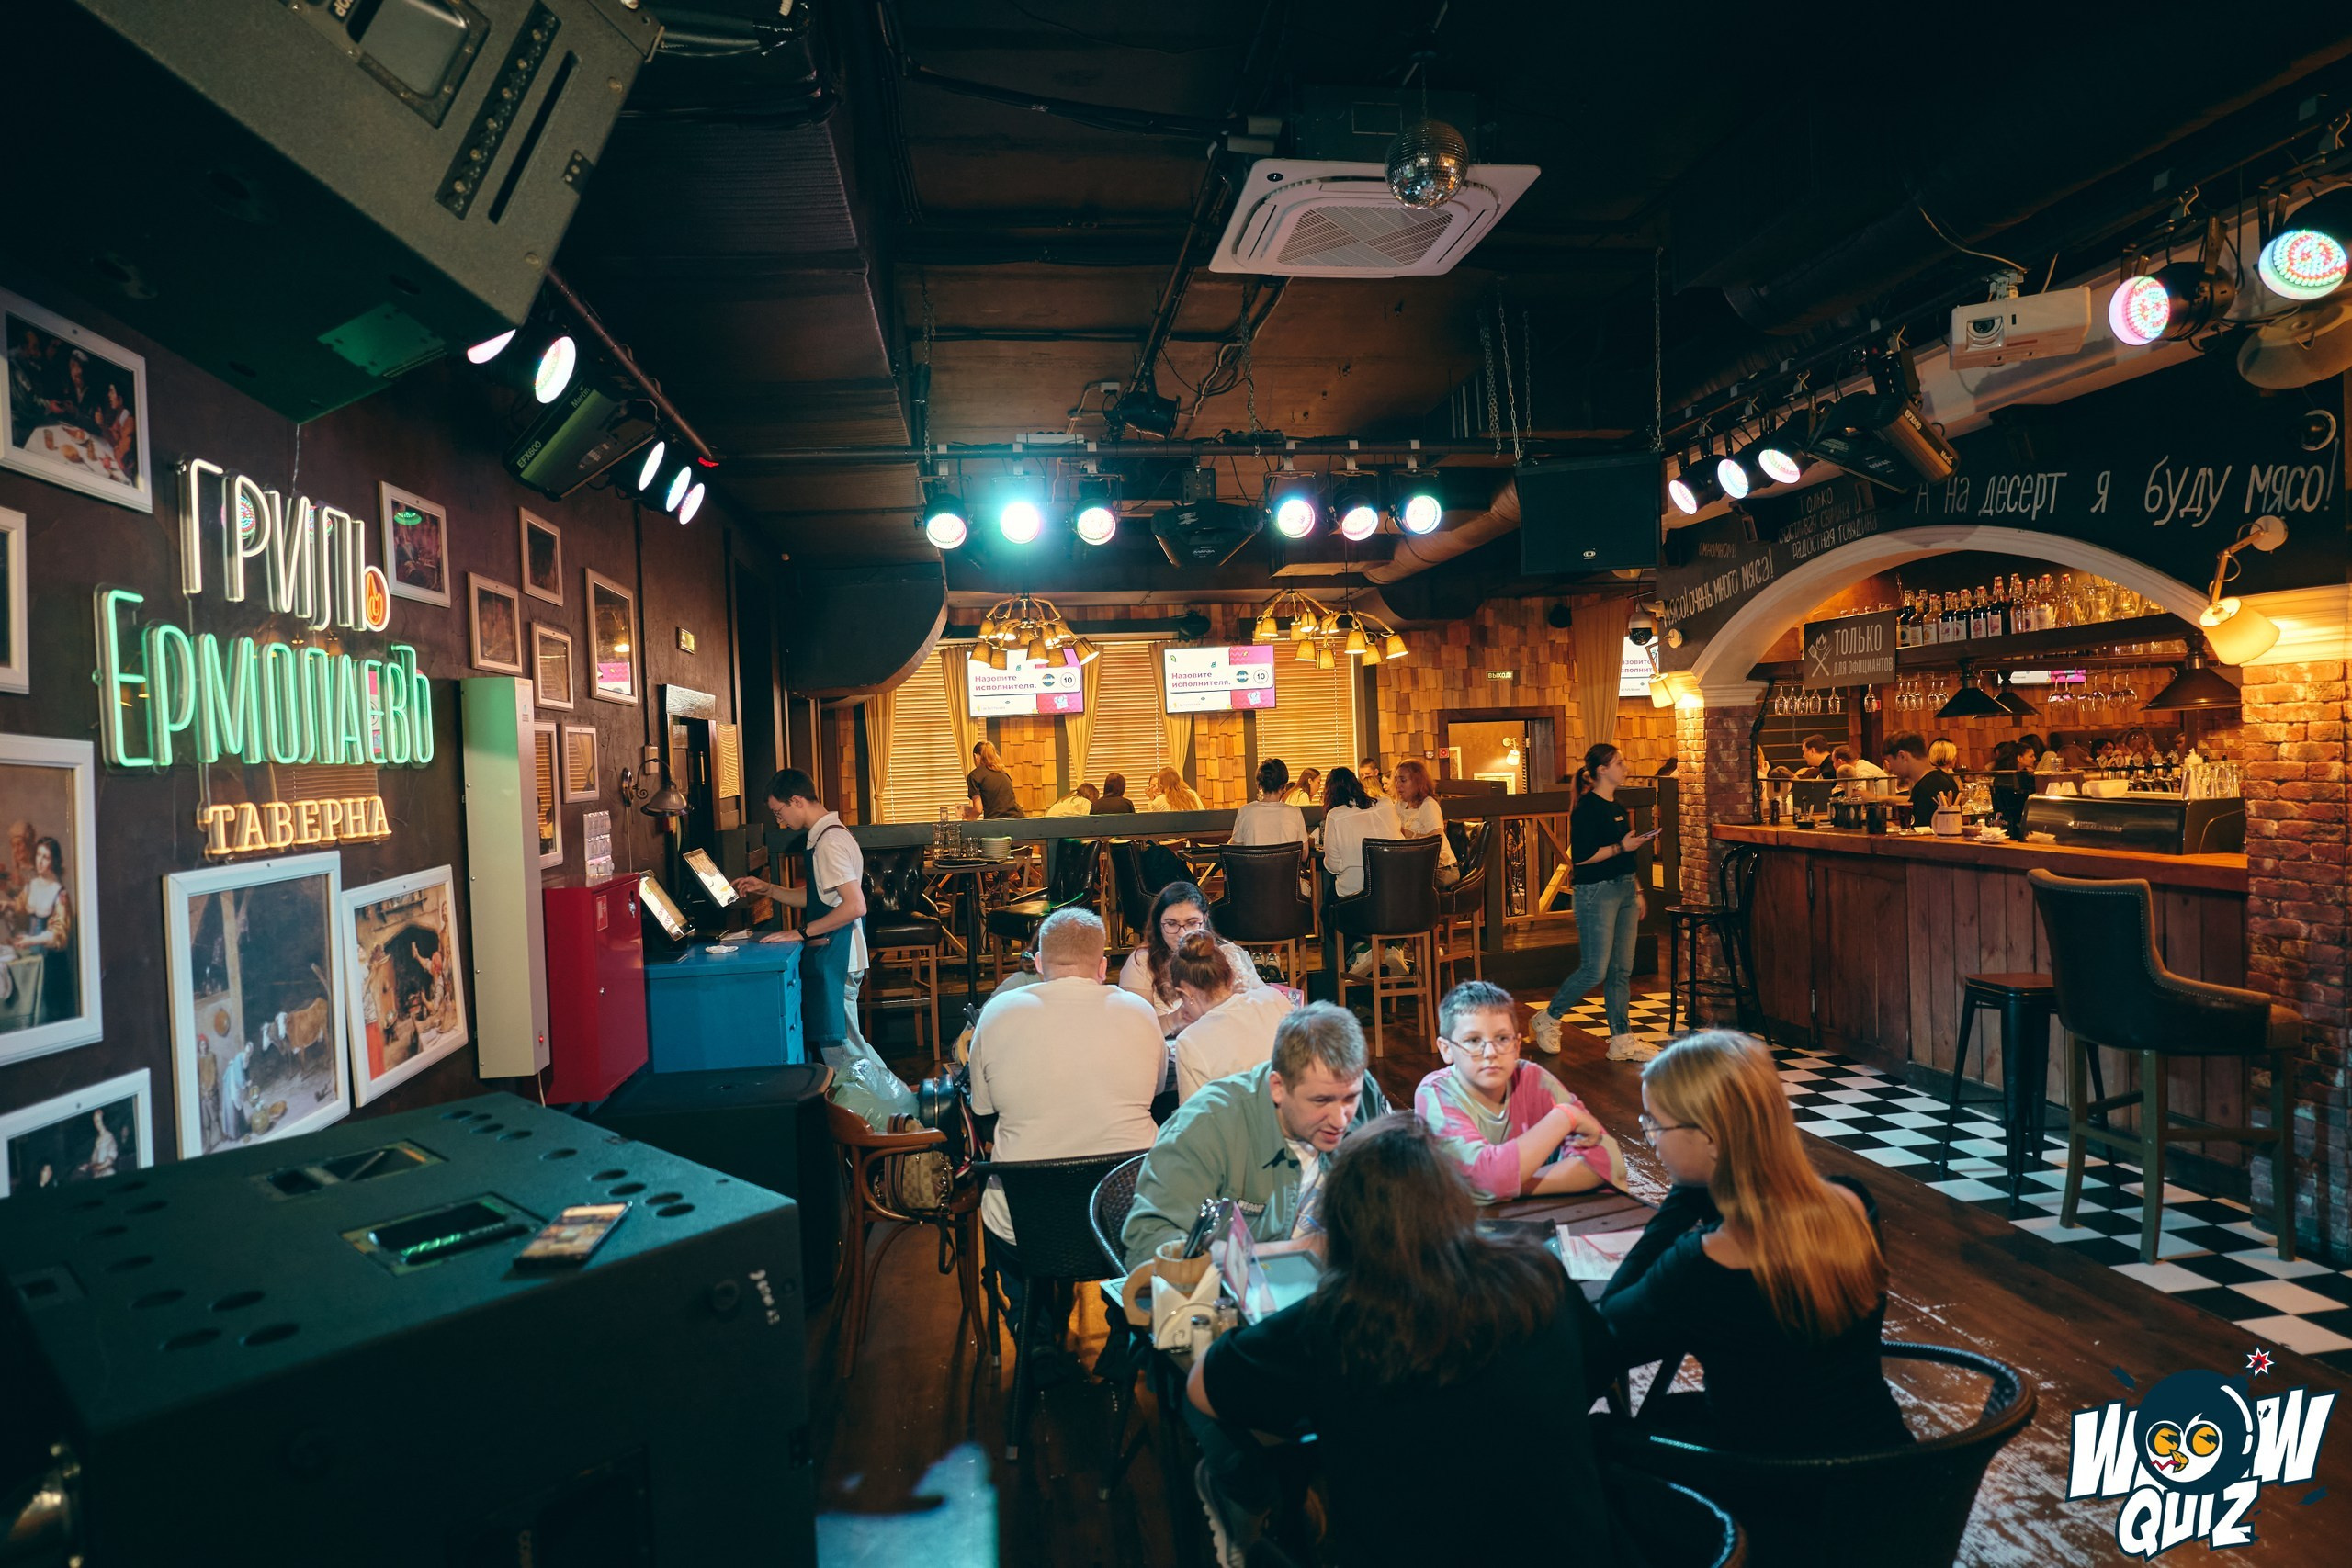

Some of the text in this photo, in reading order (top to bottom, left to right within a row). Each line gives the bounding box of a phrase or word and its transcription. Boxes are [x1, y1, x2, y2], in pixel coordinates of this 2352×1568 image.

[571, 387, 590, 408] Martin
[516, 440, 542, 469] EFX600
[1978, 471, 2067, 521] десерт
[2090, 470, 2111, 513] я
[2143, 455, 2232, 528] буду
[2245, 437, 2340, 513] мясо!
[181, 457, 390, 632] ГРИЛЬ
[1834, 624, 1883, 656] ТОЛЬКО
[99, 588, 434, 768] ЕРМОЛАЕВЪ
[1171, 671, 1213, 680] Назовите
[1833, 656, 1894, 677] ДЛЯ ОФИЦИАНТОВ
[975, 682, 1036, 691] исполнителя.
[1171, 680, 1231, 688] исполнителя.
[204, 795, 391, 855] ТАВЕРНА
